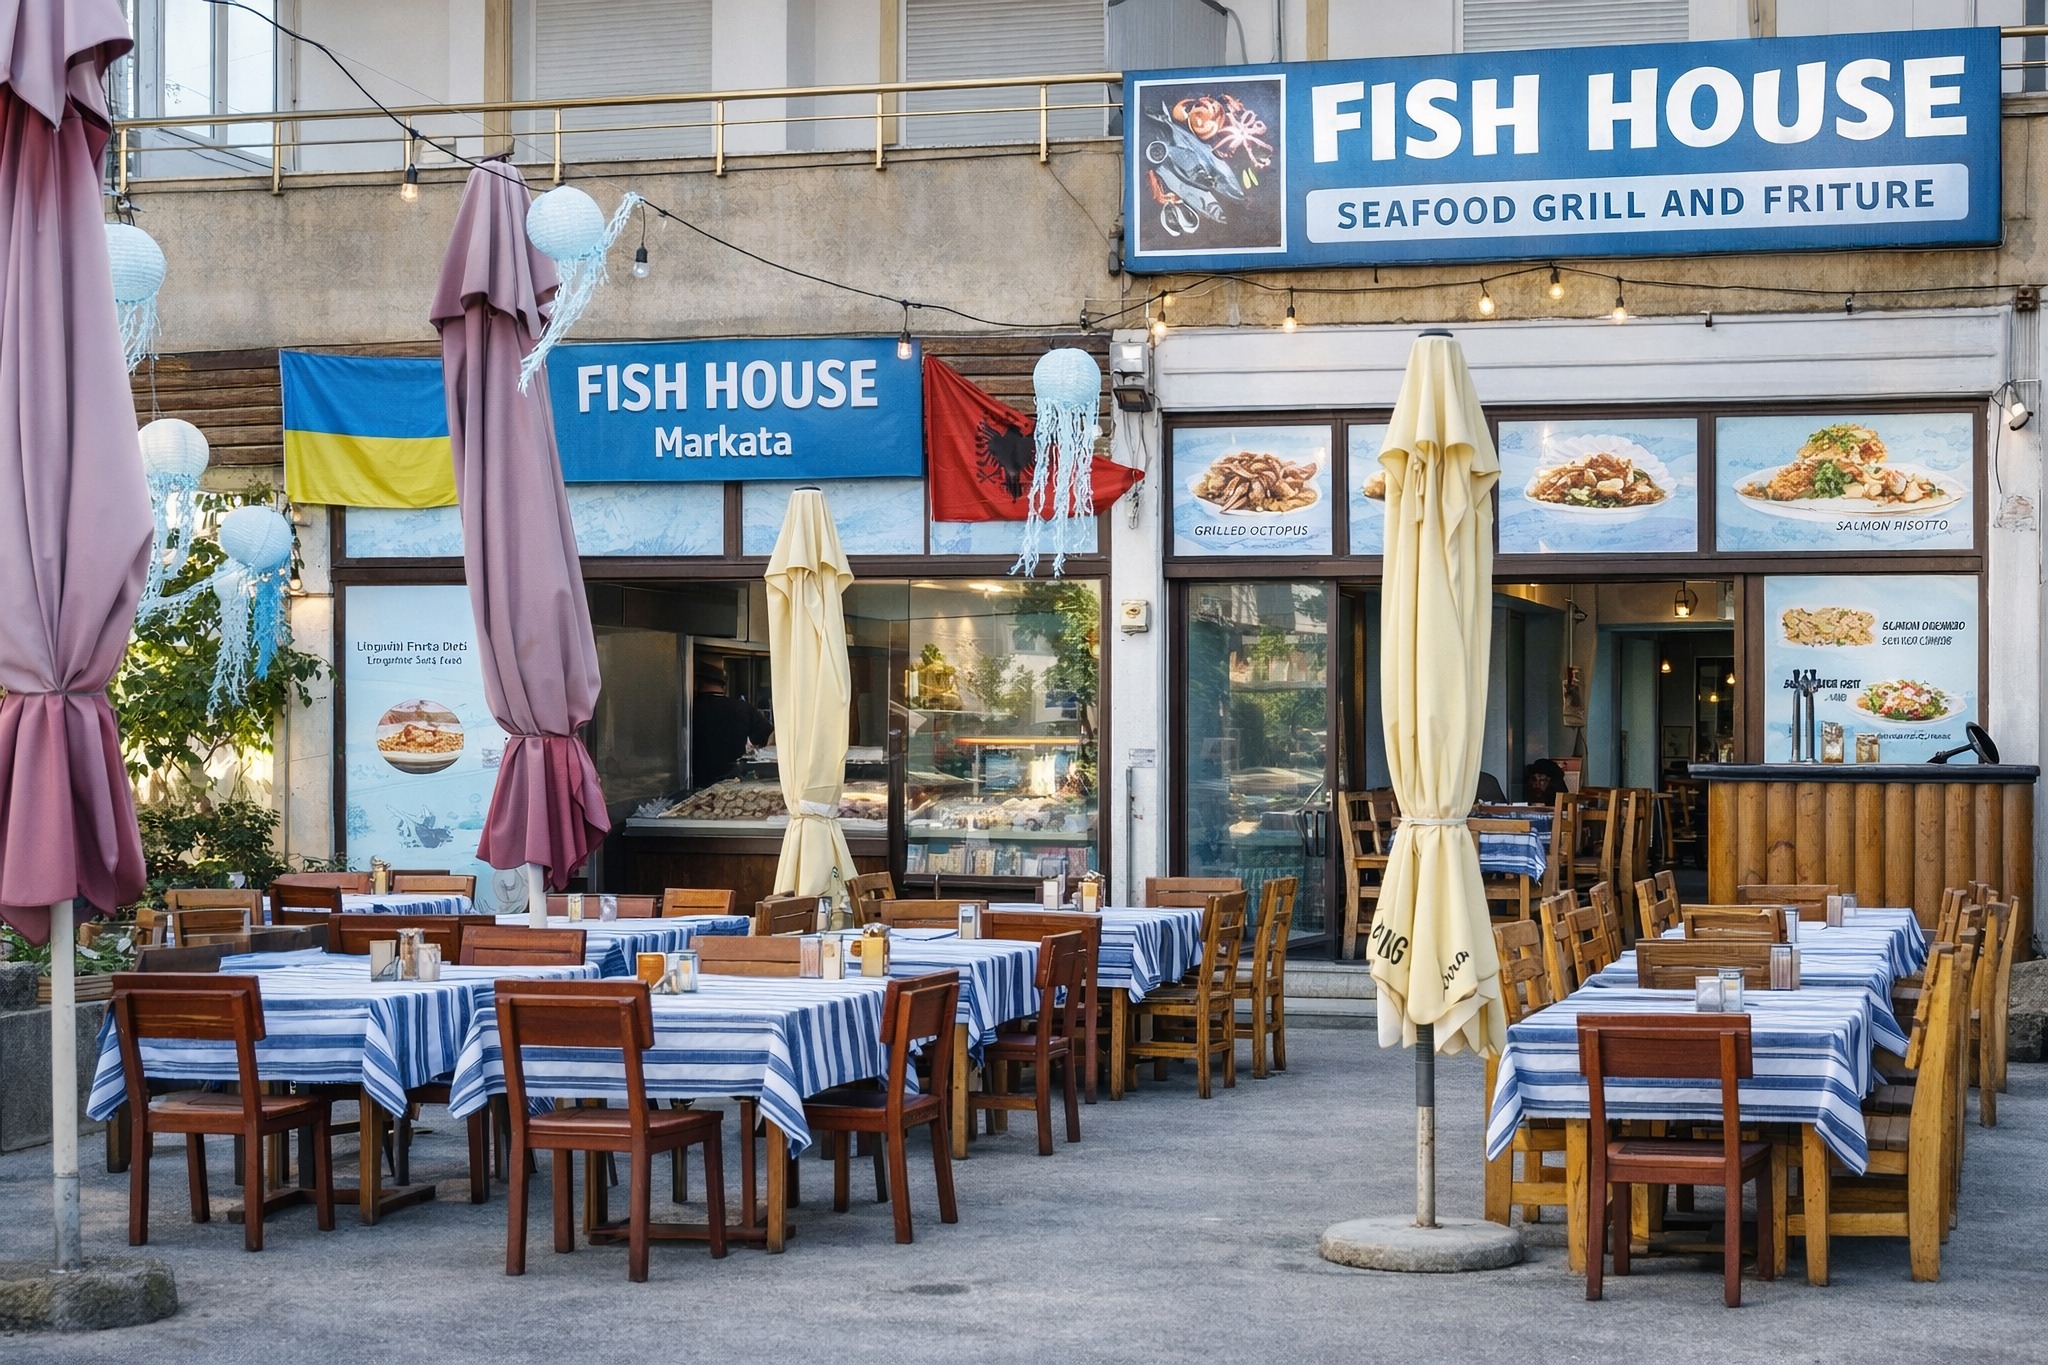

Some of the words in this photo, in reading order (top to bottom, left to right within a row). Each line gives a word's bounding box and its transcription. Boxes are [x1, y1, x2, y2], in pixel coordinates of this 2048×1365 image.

[1311, 74, 1540, 163] FISH
[1587, 56, 1968, 151] HOUSE
[1337, 195, 1517, 230] SEAFOOD
[1533, 191, 1646, 222] GRILL
[1660, 187, 1745, 218] AND
[1764, 178, 1936, 215] FRITURE
[577, 362, 687, 413] FISH
[707, 359, 879, 410] HOUSE
[655, 425, 793, 459] Markata
[1194, 525, 1247, 536] GRILLED
[1250, 525, 1309, 536] OCTOPUS
[1836, 520, 1892, 531] SALMON
